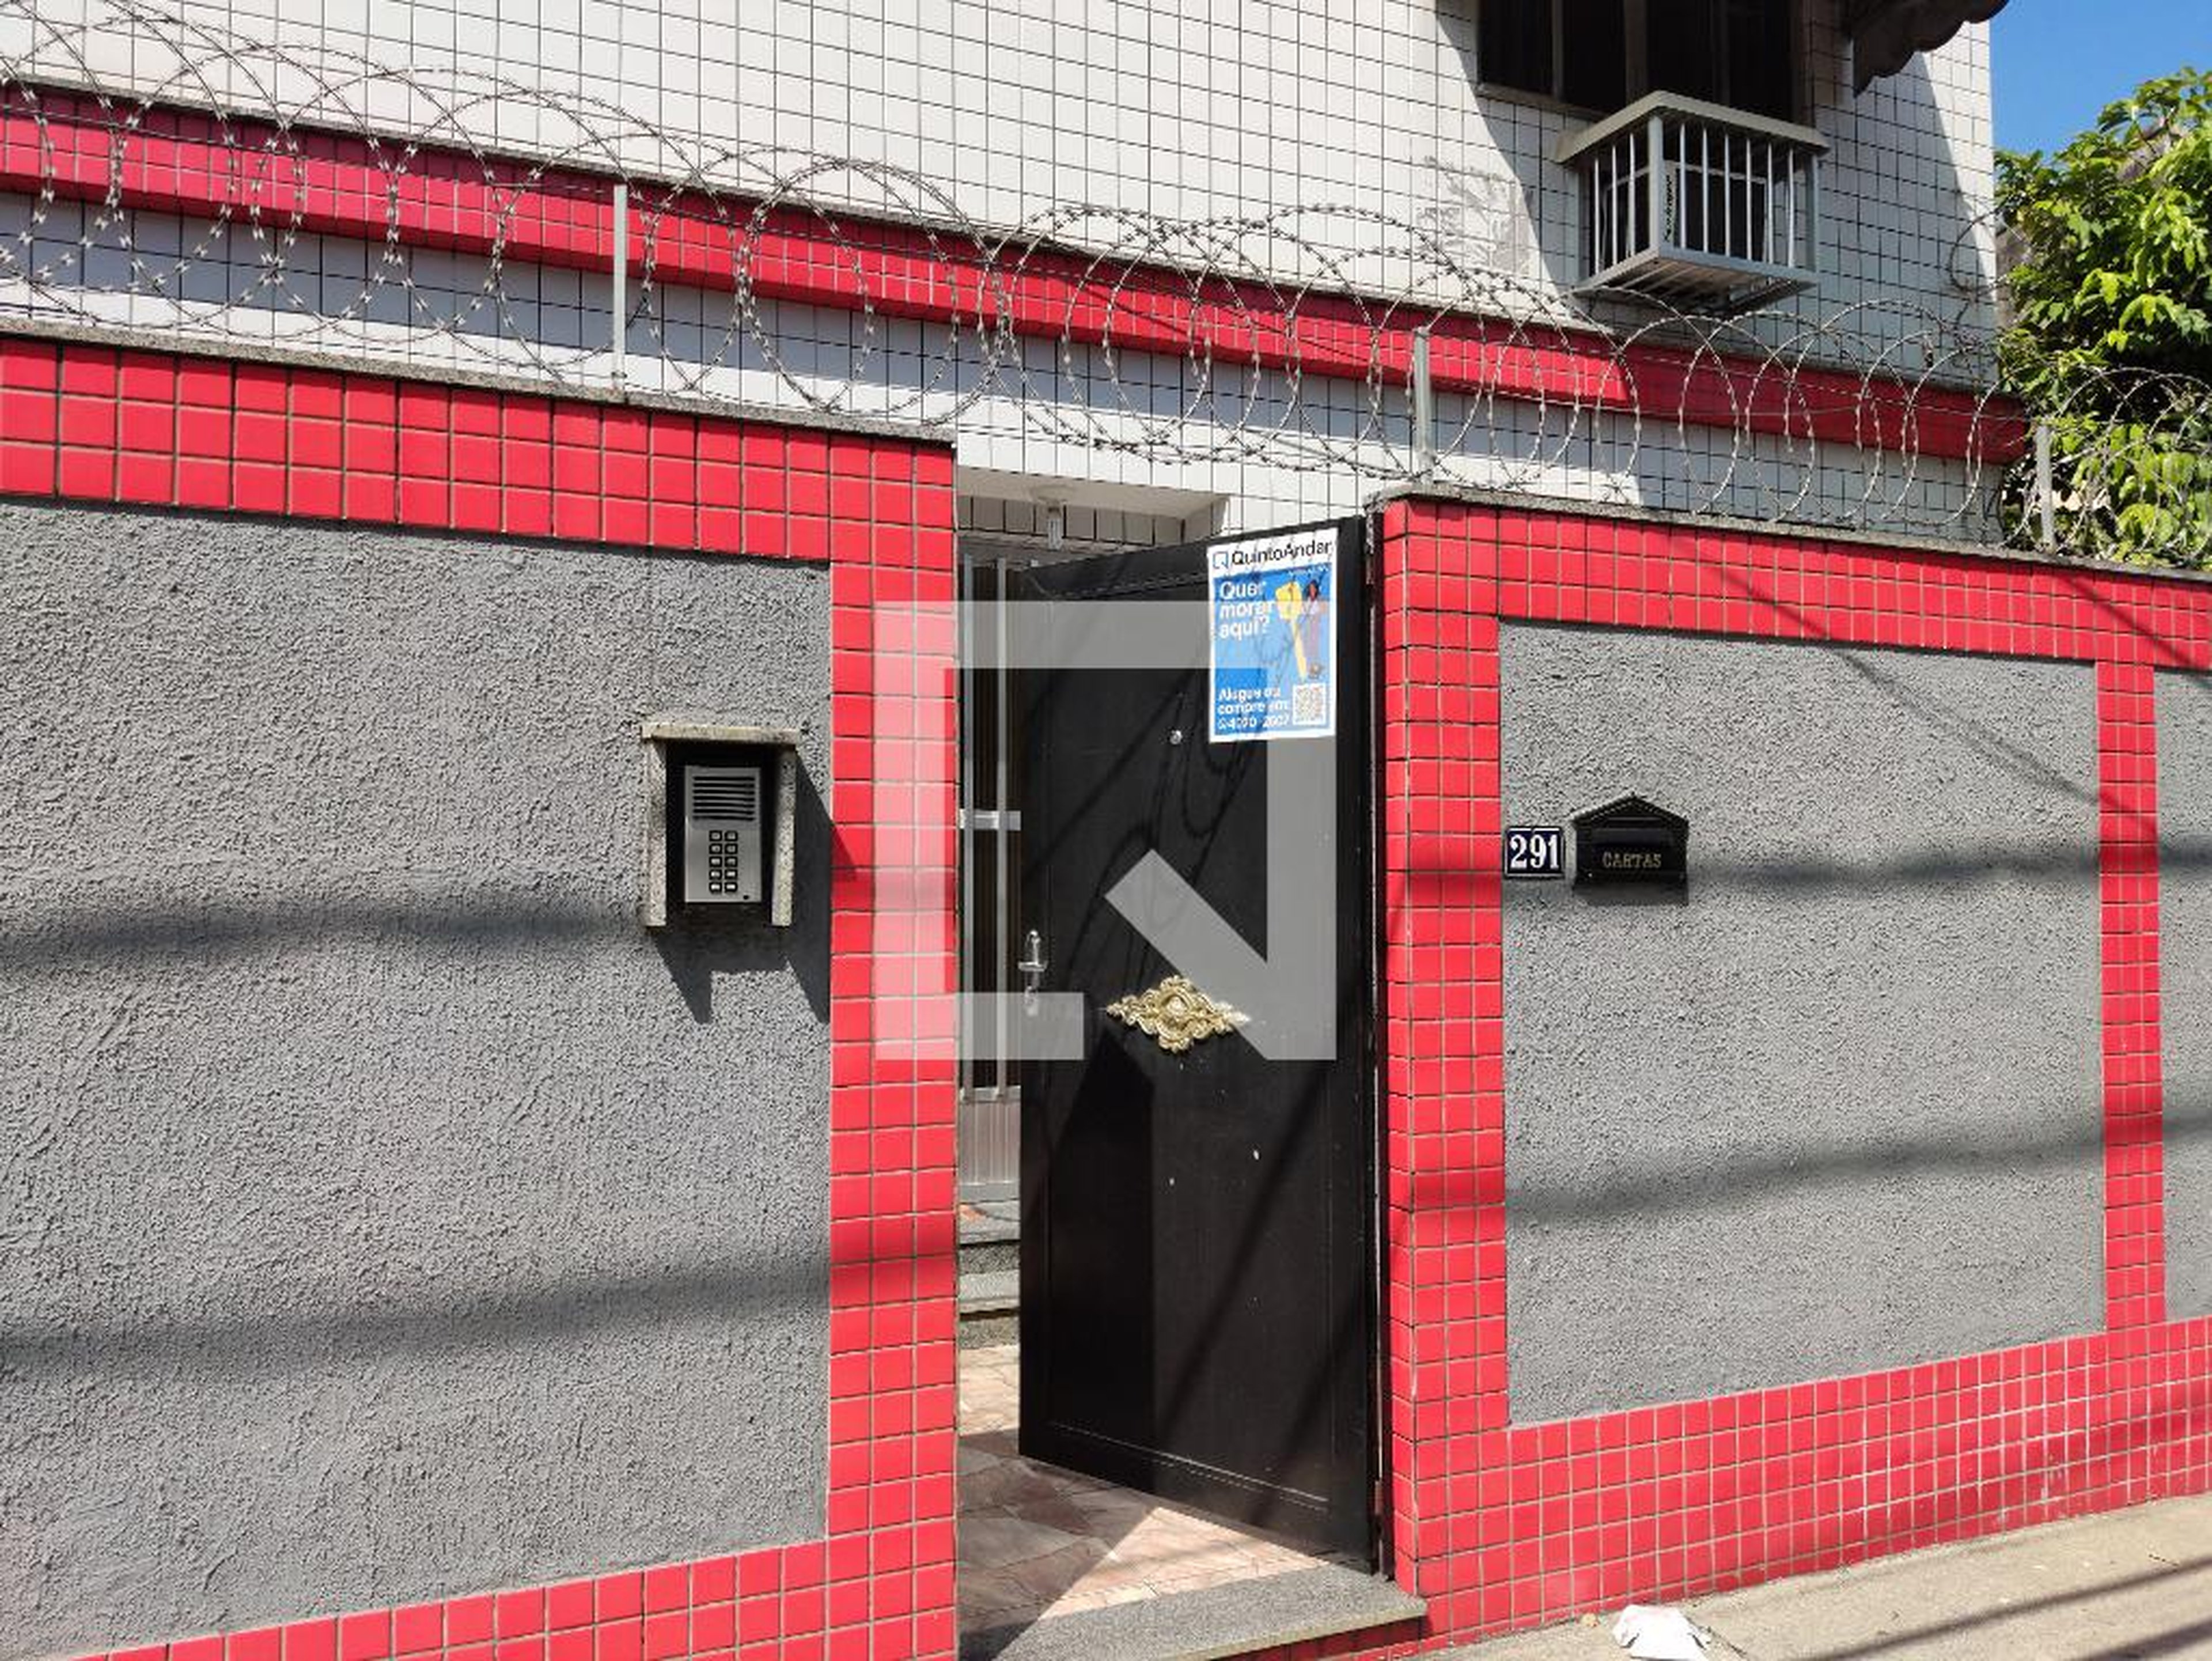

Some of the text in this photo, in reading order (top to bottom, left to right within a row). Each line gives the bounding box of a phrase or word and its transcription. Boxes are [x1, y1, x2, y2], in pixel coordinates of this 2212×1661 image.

[1232, 540, 1332, 565] QuintoAndar
[1219, 581, 1267, 600] Quer
[1219, 602, 1277, 620] morar
[1219, 618, 1271, 641] aqui?
[1510, 834, 1559, 869] 291
[1602, 851, 1661, 869] CARTAS
